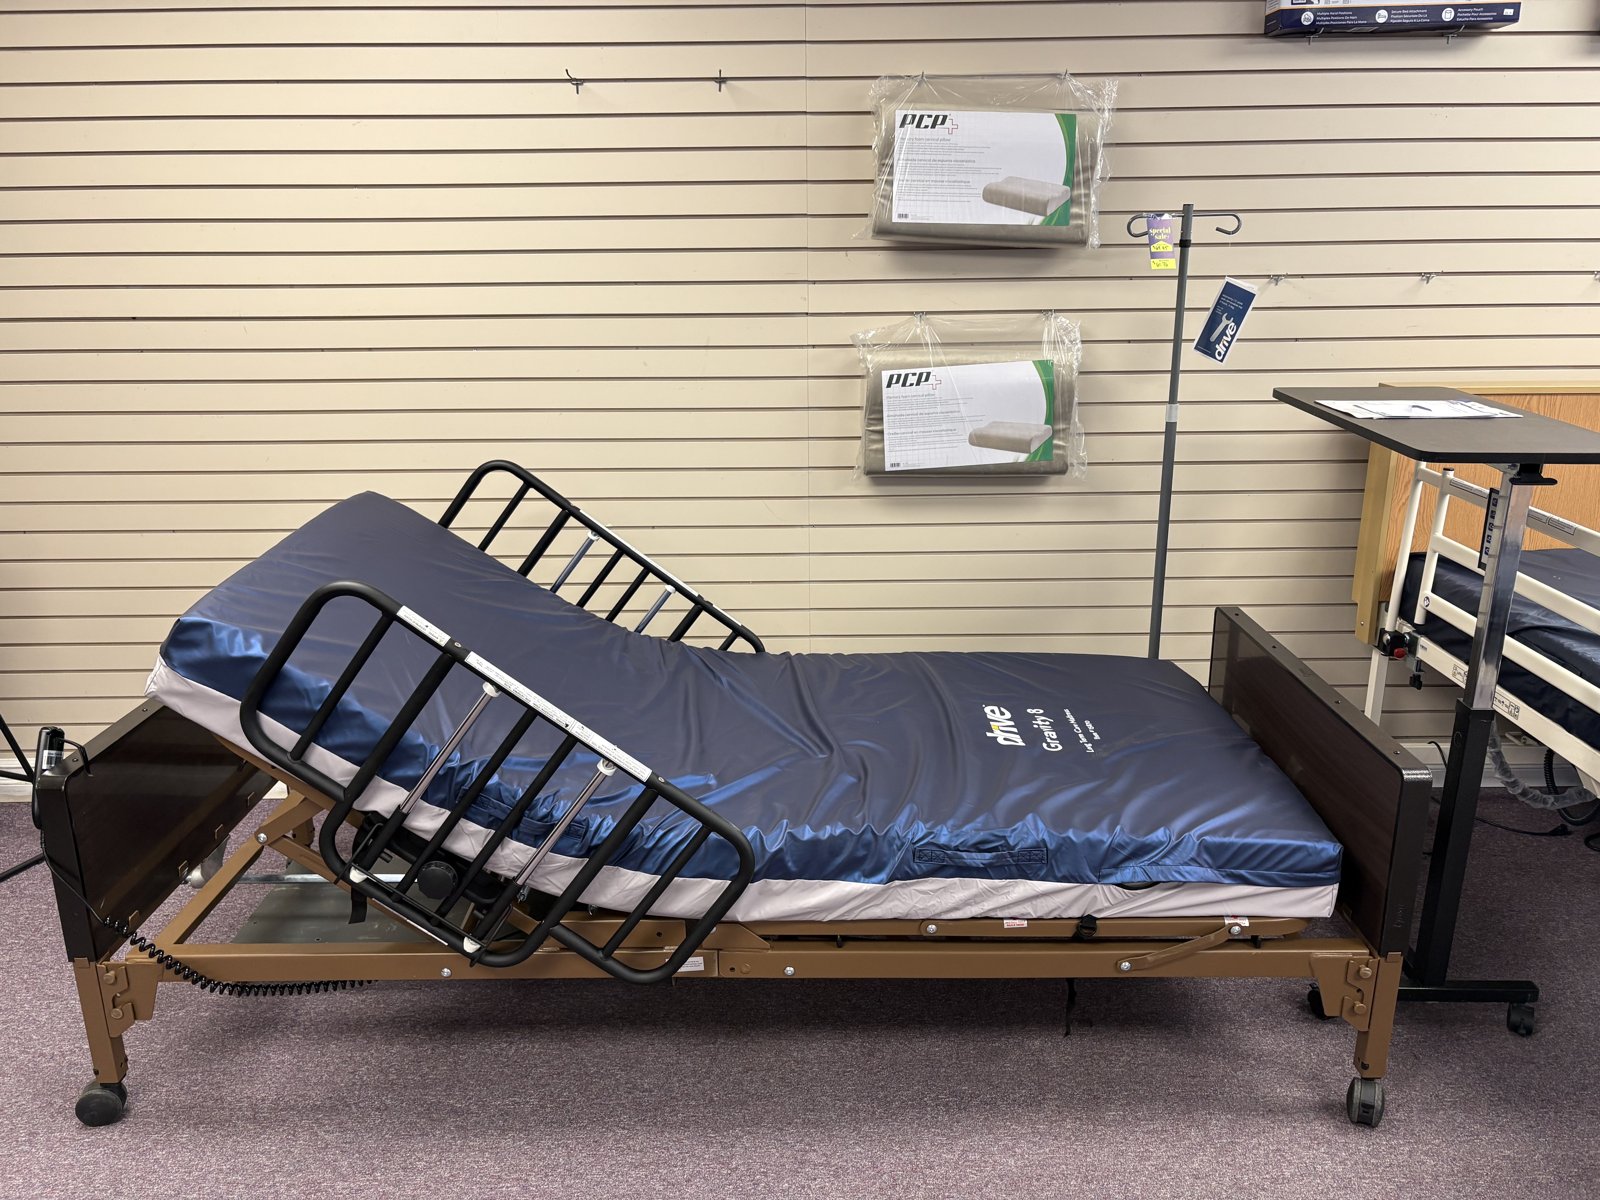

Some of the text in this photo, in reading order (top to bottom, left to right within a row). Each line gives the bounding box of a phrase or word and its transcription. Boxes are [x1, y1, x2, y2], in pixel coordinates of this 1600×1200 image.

[1149, 227, 1171, 236] special
[1214, 322, 1237, 361] drive
[984, 706, 1026, 746] drive
[1032, 715, 1064, 752] Gravity
